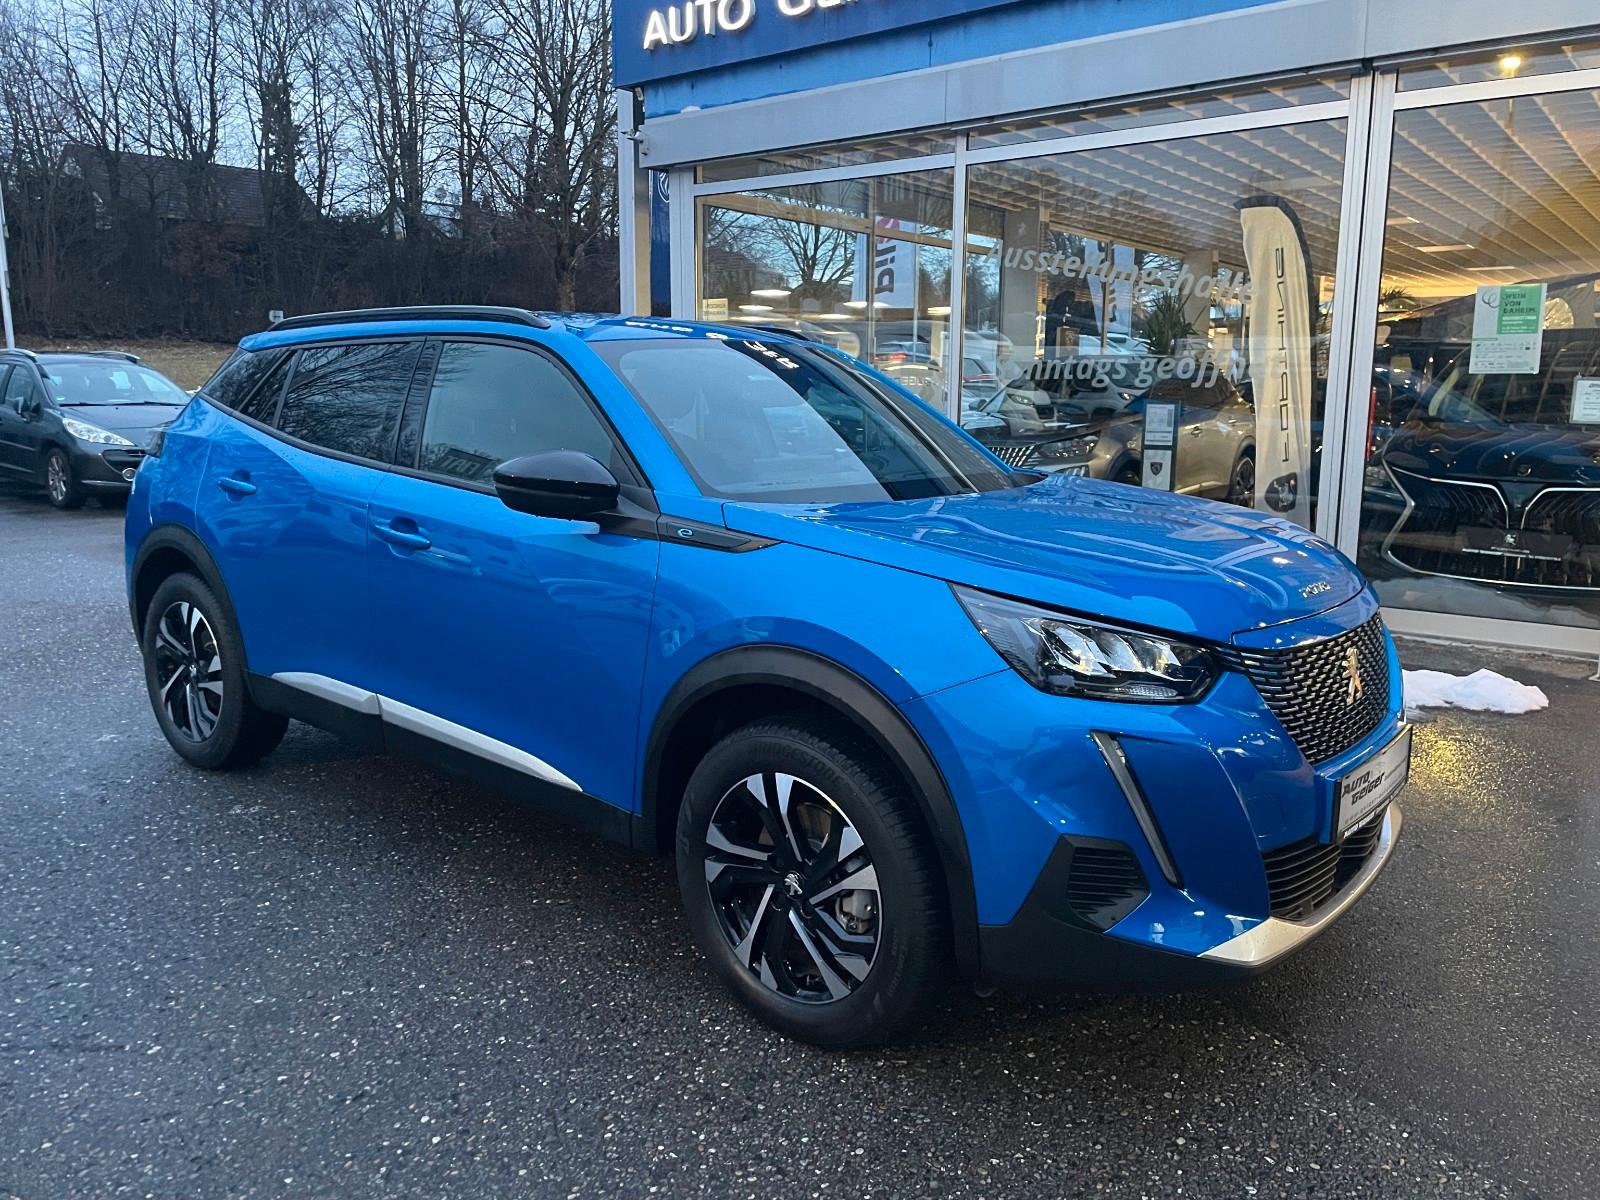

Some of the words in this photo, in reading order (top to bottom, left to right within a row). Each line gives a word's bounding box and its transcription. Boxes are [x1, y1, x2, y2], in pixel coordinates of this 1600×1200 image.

[643, 0, 754, 50] AUTO
[1002, 353, 1128, 388] nntags
[1342, 770, 1371, 798] AUTO
